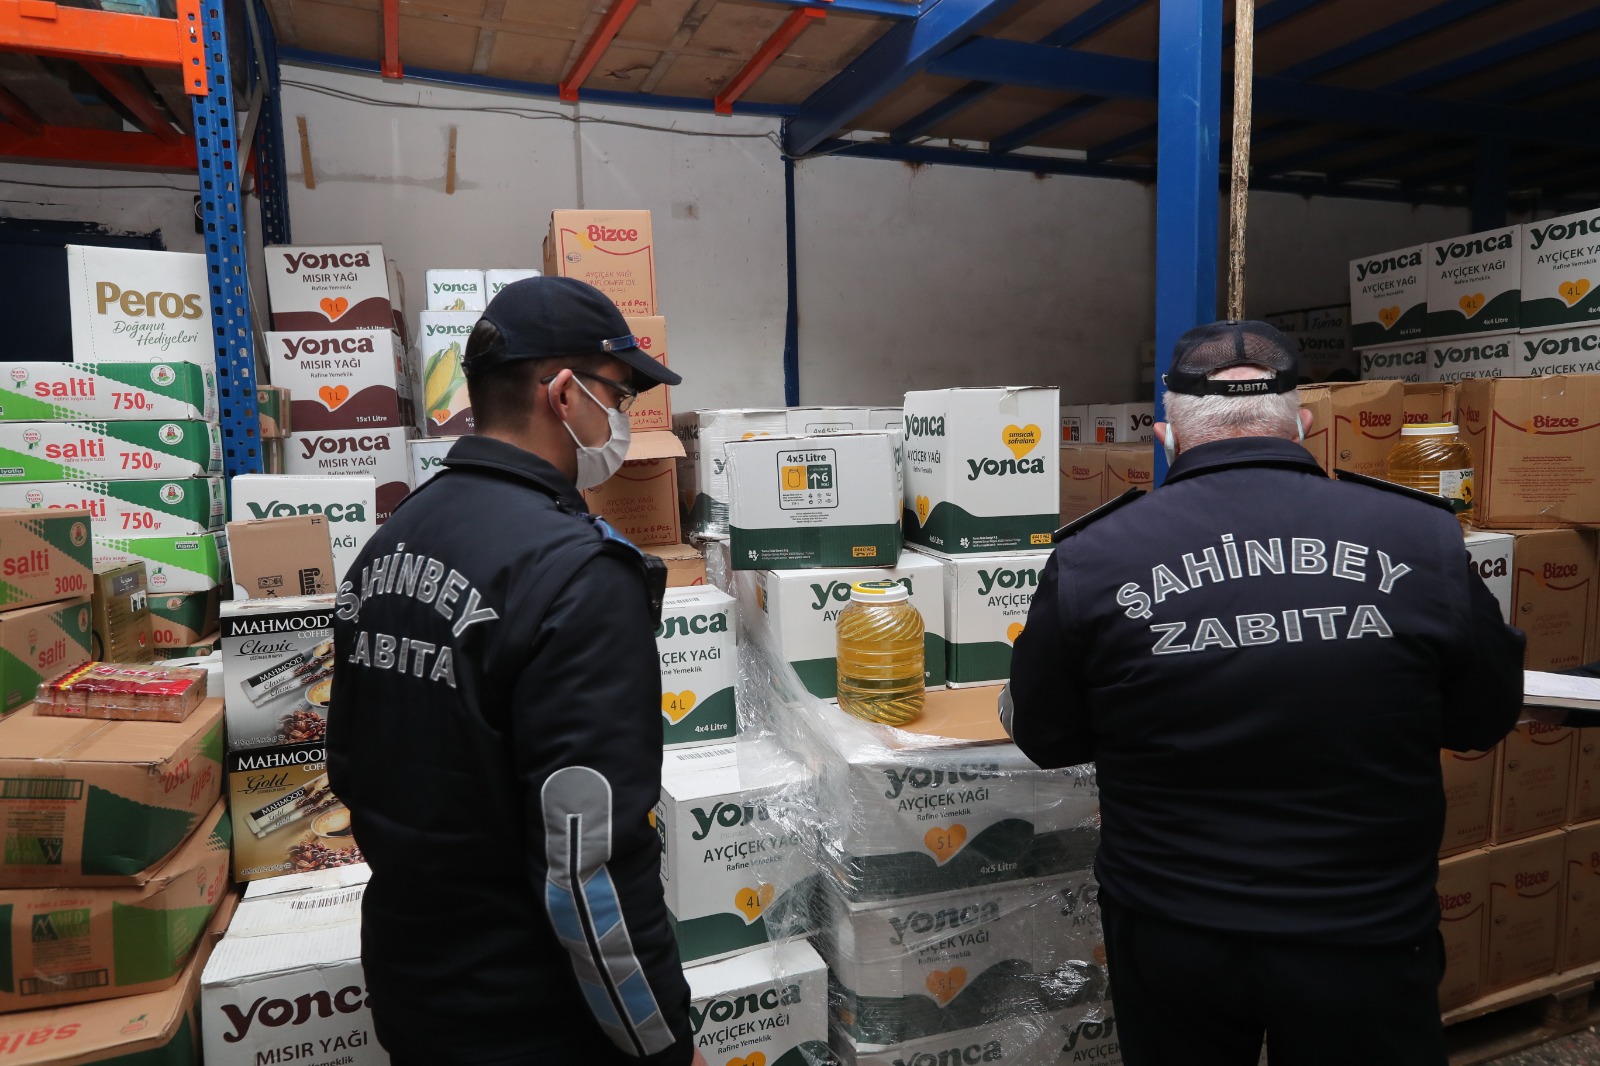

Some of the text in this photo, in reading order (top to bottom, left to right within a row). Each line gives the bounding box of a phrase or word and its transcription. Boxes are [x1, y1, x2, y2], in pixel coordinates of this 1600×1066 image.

[587, 225, 638, 241] Bizce
[1436, 234, 1512, 266] yonca
[1538, 250, 1584, 264] AYÇİÇEK
[284, 252, 370, 274] yonca
[1356, 251, 1422, 282] yonca
[1441, 260, 1506, 279] AYÇİÇEK YAĞI
[302, 272, 358, 282] MISIR YAĞI
[1362, 276, 1416, 294] AYÇİÇEK YAĞI
[433, 283, 478, 294] yonca
[1568, 287, 1580, 296] 4 L
[96, 281, 203, 320] Peros
[113, 321, 166, 338] Doğanın
[137, 332, 199, 351] Hediyeleri
[282, 337, 374, 360] yonca
[1298, 337, 1344, 352] yonca
[300, 358, 360, 370] MISIR YAĞI
[1364, 350, 1426, 372] yonca
[1434, 342, 1510, 368] yonca
[34, 378, 95, 397] salti
[1228, 382, 1268, 393] ZABITA
[905, 413, 946, 441] yonca
[1360, 411, 1392, 428] Bizce
[1533, 415, 1579, 428] Bizce
[46, 438, 104, 458] salti
[300, 436, 390, 460] yonca
[908, 449, 940, 465] AYÇİÇEK YAĞI
[318, 456, 376, 468] MISIR YAĞI
[786, 454, 826, 462] 4x5 Litre
[822, 472, 828, 482] 6
[967, 458, 1045, 480] yonca
[1072, 466, 1090, 475] Bizce
[1128, 468, 1150, 479] Bizce
[333, 535, 356, 548] AĞI
[4, 549, 49, 576] salti
[1543, 562, 1578, 579] Bizce
[1116, 533, 1412, 620] ŞAHİNBEY
[336, 542, 500, 638] ŞAHİNBEY
[230, 615, 330, 636] MAHMOOD
[298, 630, 330, 639] COFFEE
[1150, 604, 1394, 655] ZABITA
[38, 638, 66, 668] salti
[236, 640, 298, 656] Classic
[690, 646, 721, 661] YAĞI
[348, 631, 456, 688] ABITA
[260, 656, 303, 682] MAHMOOD
[673, 666, 702, 674] Yemeklik
[670, 702, 686, 710] 4 L
[710, 723, 728, 731] Litre
[241, 773, 293, 794] Gold
[261, 788, 304, 816] MAHMOOD
[898, 787, 989, 812] AYÇİÇEK YAĞI
[917, 813, 938, 822] Rafine
[704, 840, 764, 863] AYÇİÇEK
[937, 836, 944, 849] 5
[726, 862, 750, 871] Rafine
[980, 862, 1017, 874] 4x5 Litre
[1515, 871, 1549, 890] Bizce
[746, 897, 754, 908] 4
[959, 930, 990, 946] YAĞI
[221, 986, 372, 1043] yonc
[689, 984, 802, 1036] yonca
[698, 1013, 790, 1048] AYÇİÇEK YAĞI
[256, 1030, 368, 1066] MISIR YAĞI
[718, 1034, 772, 1054] Rafine Yemeklik
